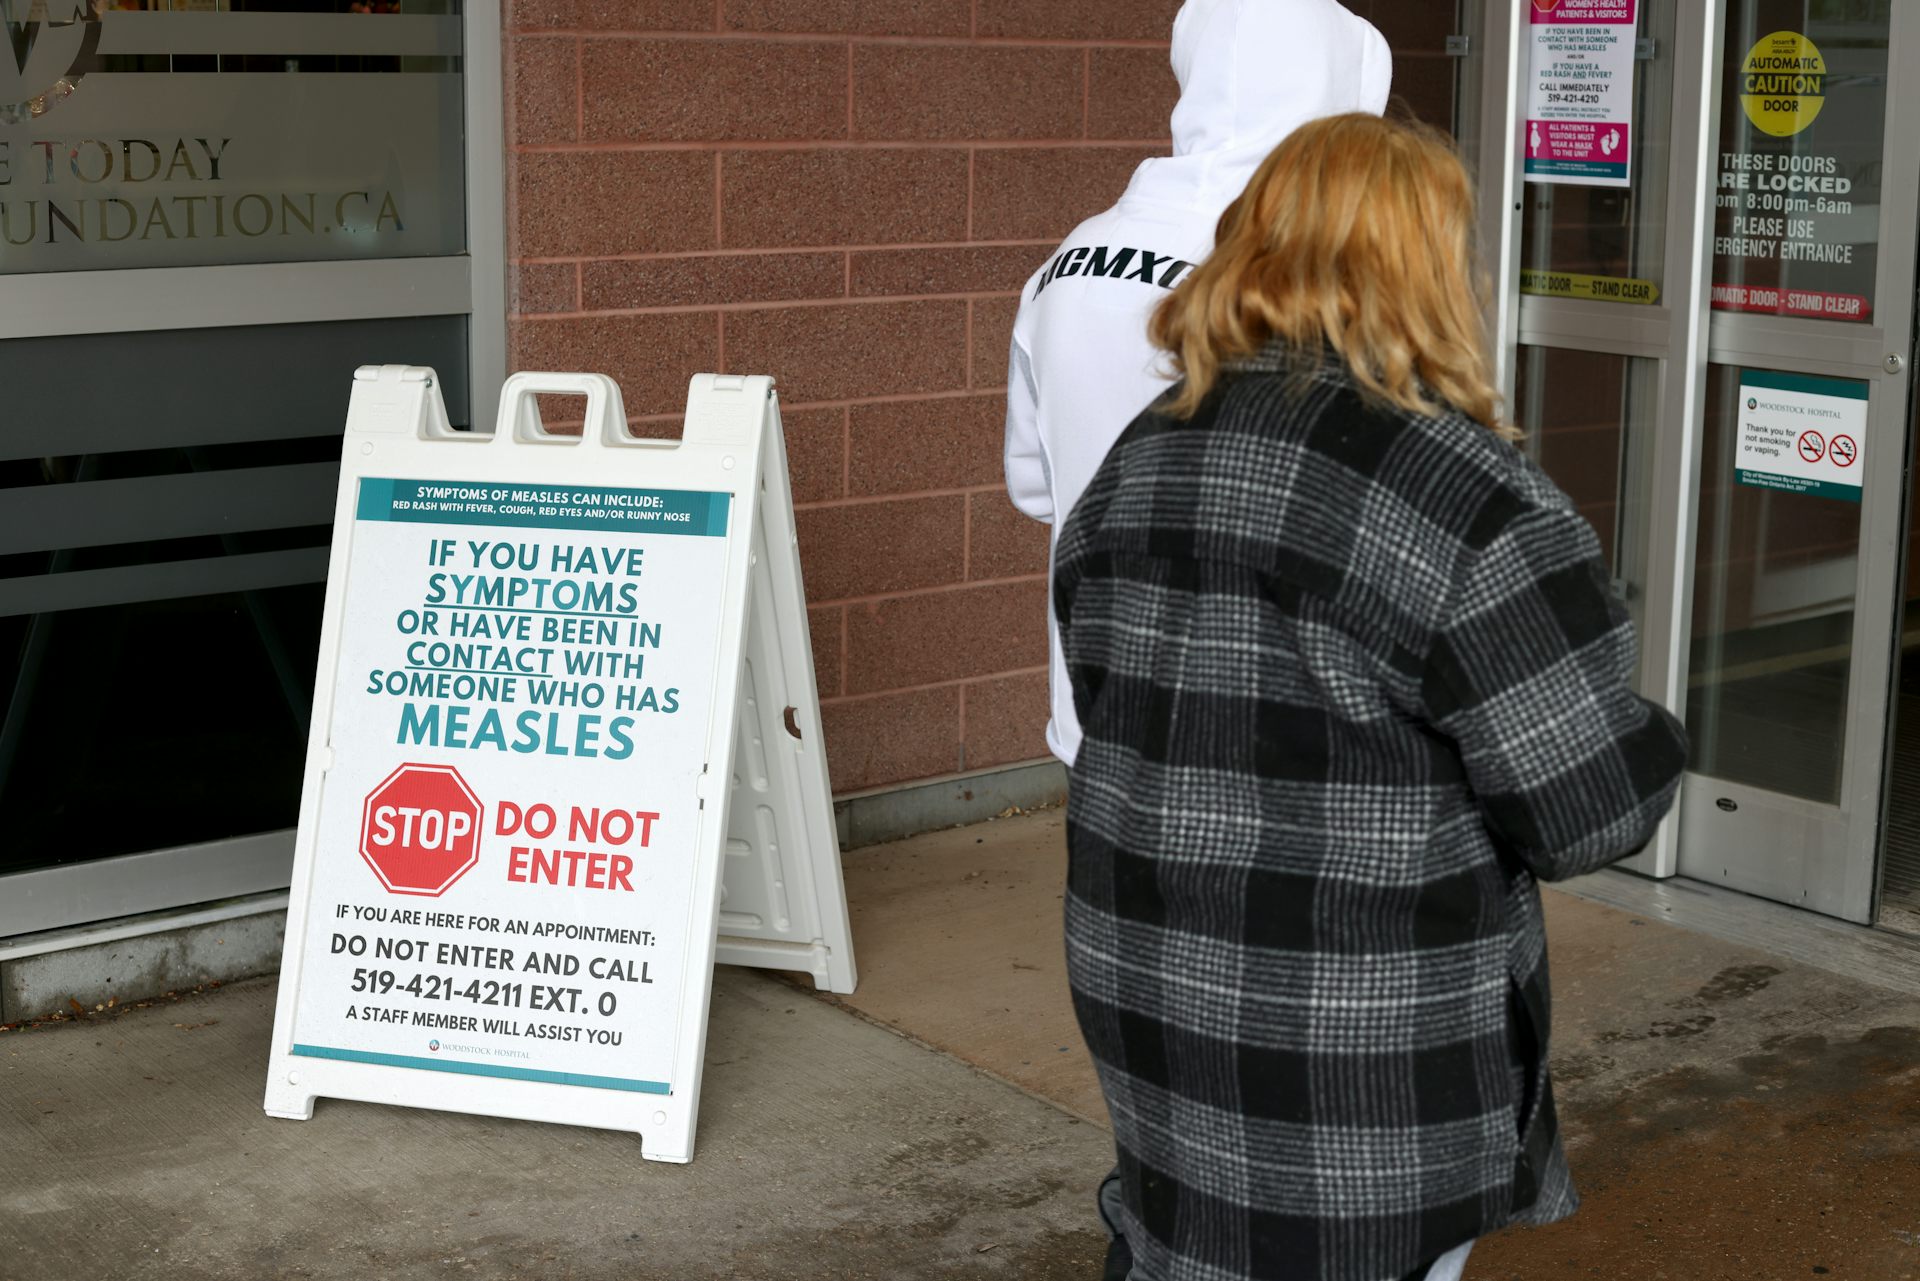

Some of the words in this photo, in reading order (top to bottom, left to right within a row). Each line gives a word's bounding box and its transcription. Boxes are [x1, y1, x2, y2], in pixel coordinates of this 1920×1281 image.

[1556, 10, 1588, 18] PATIENTS
[1588, 10, 1595, 18] &
[1596, 10, 1627, 18] VISITORS
[1749, 57, 1818, 70] AUTOMATIC
[1539, 83, 1557, 91] CALL
[1560, 83, 1609, 92] IMMEDIATELY
[1745, 74, 1820, 94] CAUTION
[1548, 94, 1599, 103] 519-421-4210
[1763, 100, 1799, 112] DOOR
[1561, 124, 1589, 132] PATIENTS
[1575, 142, 1593, 150] MASK
[31, 138, 232, 185] TODAY
[1722, 153, 1773, 171] THESE
[1779, 156, 1836, 174] DOORS
[1717, 172, 1750, 189] RE
[1757, 174, 1851, 194] LOCKED
[1746, 193, 1852, 214] 8:00pm-6am
[1733, 216, 1784, 236] PLEASE
[1787, 220, 1815, 239] USE
[1780, 241, 1853, 264] ENTRANCE
[1548, 276, 1571, 292] DOOR
[1592, 280, 1620, 297] STAND
[1622, 282, 1649, 299] CLEAR
[1750, 289, 1779, 307] DOOR
[1788, 293, 1822, 311] STAND
[1825, 296, 1860, 315] CLEAR
[1760, 402, 1805, 414] WOODSTOCK
[1808, 408, 1842, 419] HOSPITAL
[1746, 423, 1768, 433] Thank
[1770, 427, 1784, 436] you
[1786, 428, 1796, 437] for
[1754, 445, 1781, 456] vaping.
[1759, 436, 1791, 448] smoking
[417, 486, 488, 500] SYMPTOMS
[491, 489, 508, 501] OF
[511, 490, 569, 504] MEASLES
[572, 493, 601, 505] CAN
[604, 494, 664, 508] INCLUDE:
[392, 500, 410, 509] RED
[412, 501, 438, 511] RASH
[439, 502, 464, 512] WITH
[465, 503, 497, 514] FEVER,
[499, 505, 536, 516] COUGH,
[538, 507, 557, 516] RED
[559, 508, 583, 517] EYES
[584, 509, 625, 519] AND/OR
[627, 511, 662, 521] RUNNY
[663, 512, 691, 522] NOSE
[429, 540, 456, 566] IF
[468, 541, 539, 571] YOU
[551, 545, 643, 576] HAVE
[425, 573, 638, 614] SYMPTOMS
[397, 610, 438, 635] OR
[450, 612, 531, 640] HAVE
[542, 618, 618, 645] BEEN
[629, 622, 661, 648] IN
[406, 642, 553, 674] CONTACT
[564, 650, 643, 679] WITH
[367, 670, 517, 703] SOMEONE
[528, 680, 604, 708] WHO
[616, 685, 679, 713] HAS
[397, 703, 635, 760] MEASLES
[372, 806, 471, 850] STOP
[496, 801, 556, 839] DO
[569, 807, 659, 847] NOT
[508, 847, 634, 891] ENTER
[337, 904, 349, 918] IF
[354, 906, 387, 922] YOU
[390, 910, 421, 925] ARE
[426, 912, 464, 929] HERE
[469, 916, 499, 932] FOR
[504, 920, 528, 934] AN
[533, 922, 655, 946] APPOINTMENT:
[331, 933, 366, 956] DO
[376, 938, 429, 962] NOT
[437, 943, 514, 970] ENTER
[523, 952, 579, 975] AND
[589, 958, 652, 983] CALL
[351, 968, 521, 1007] 519-421-4211
[530, 985, 588, 1014] EXT.
[598, 992, 616, 1016] 0
[346, 1005, 357, 1019] A
[362, 1007, 408, 1024] STAFF
[412, 1012, 477, 1031] MEMBER
[483, 1019, 520, 1036] WILL
[525, 1024, 582, 1042] ASSIST
[587, 1029, 622, 1046] YOU
[442, 1043, 491, 1055] WOODSTOCK
[494, 1049, 530, 1059] HOSPITAL
